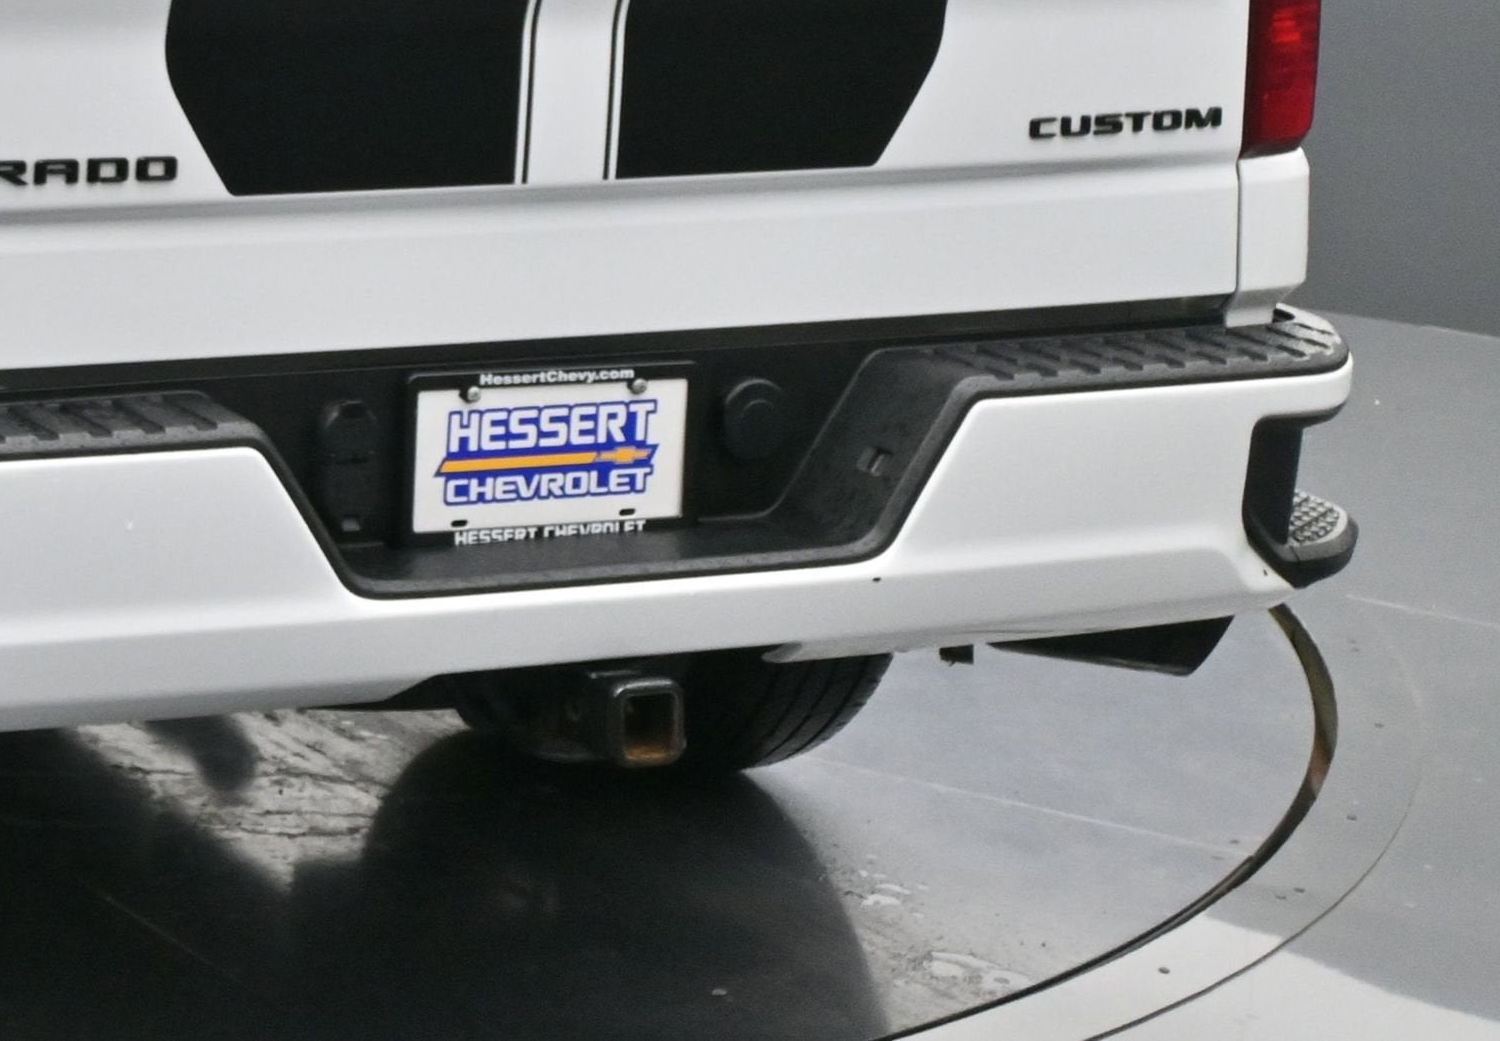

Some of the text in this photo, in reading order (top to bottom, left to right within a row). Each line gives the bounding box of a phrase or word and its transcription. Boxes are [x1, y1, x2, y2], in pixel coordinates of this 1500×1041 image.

[1028, 106, 1223, 140] CUSTOM
[479, 368, 635, 386] HessertChevy.com
[447, 400, 657, 453] HESSERT
[444, 467, 653, 504] CHEVROLET
[454, 527, 538, 546] HESSERT
